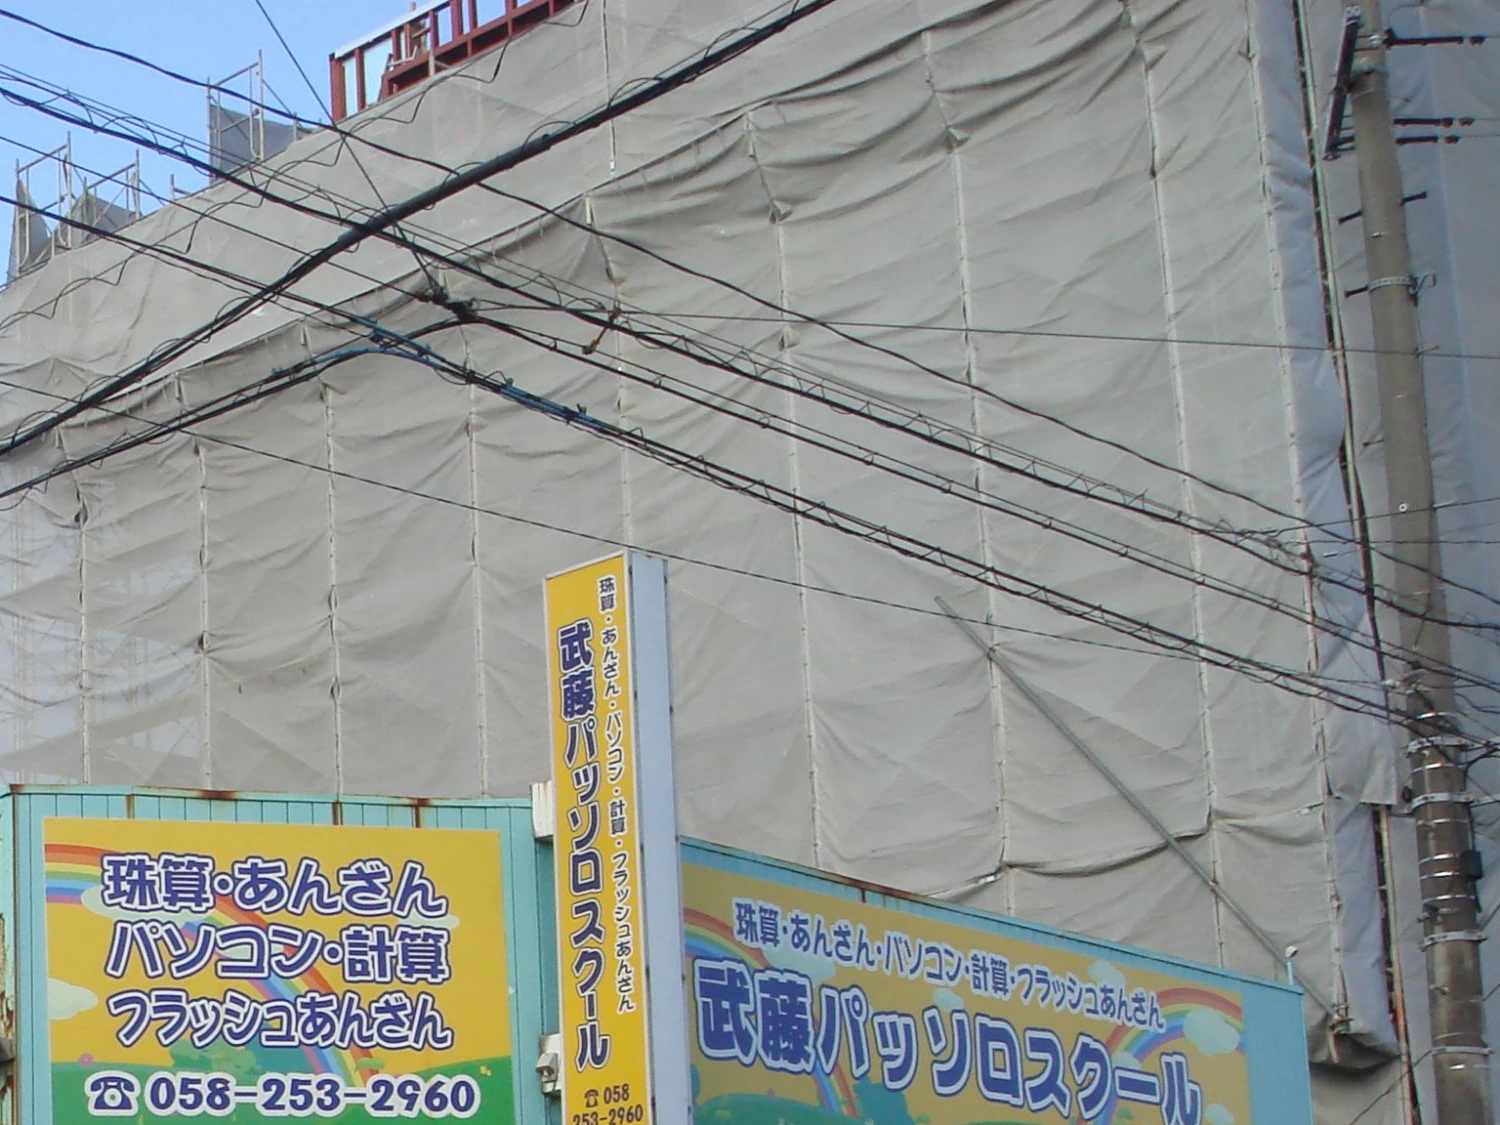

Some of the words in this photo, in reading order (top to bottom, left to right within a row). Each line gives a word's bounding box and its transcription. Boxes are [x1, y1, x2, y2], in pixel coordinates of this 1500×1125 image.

[108, 989, 453, 1050] フラッシュあんざん
[148, 1073, 478, 1116] 058-253-2960
[603, 1084, 630, 1105] 058
